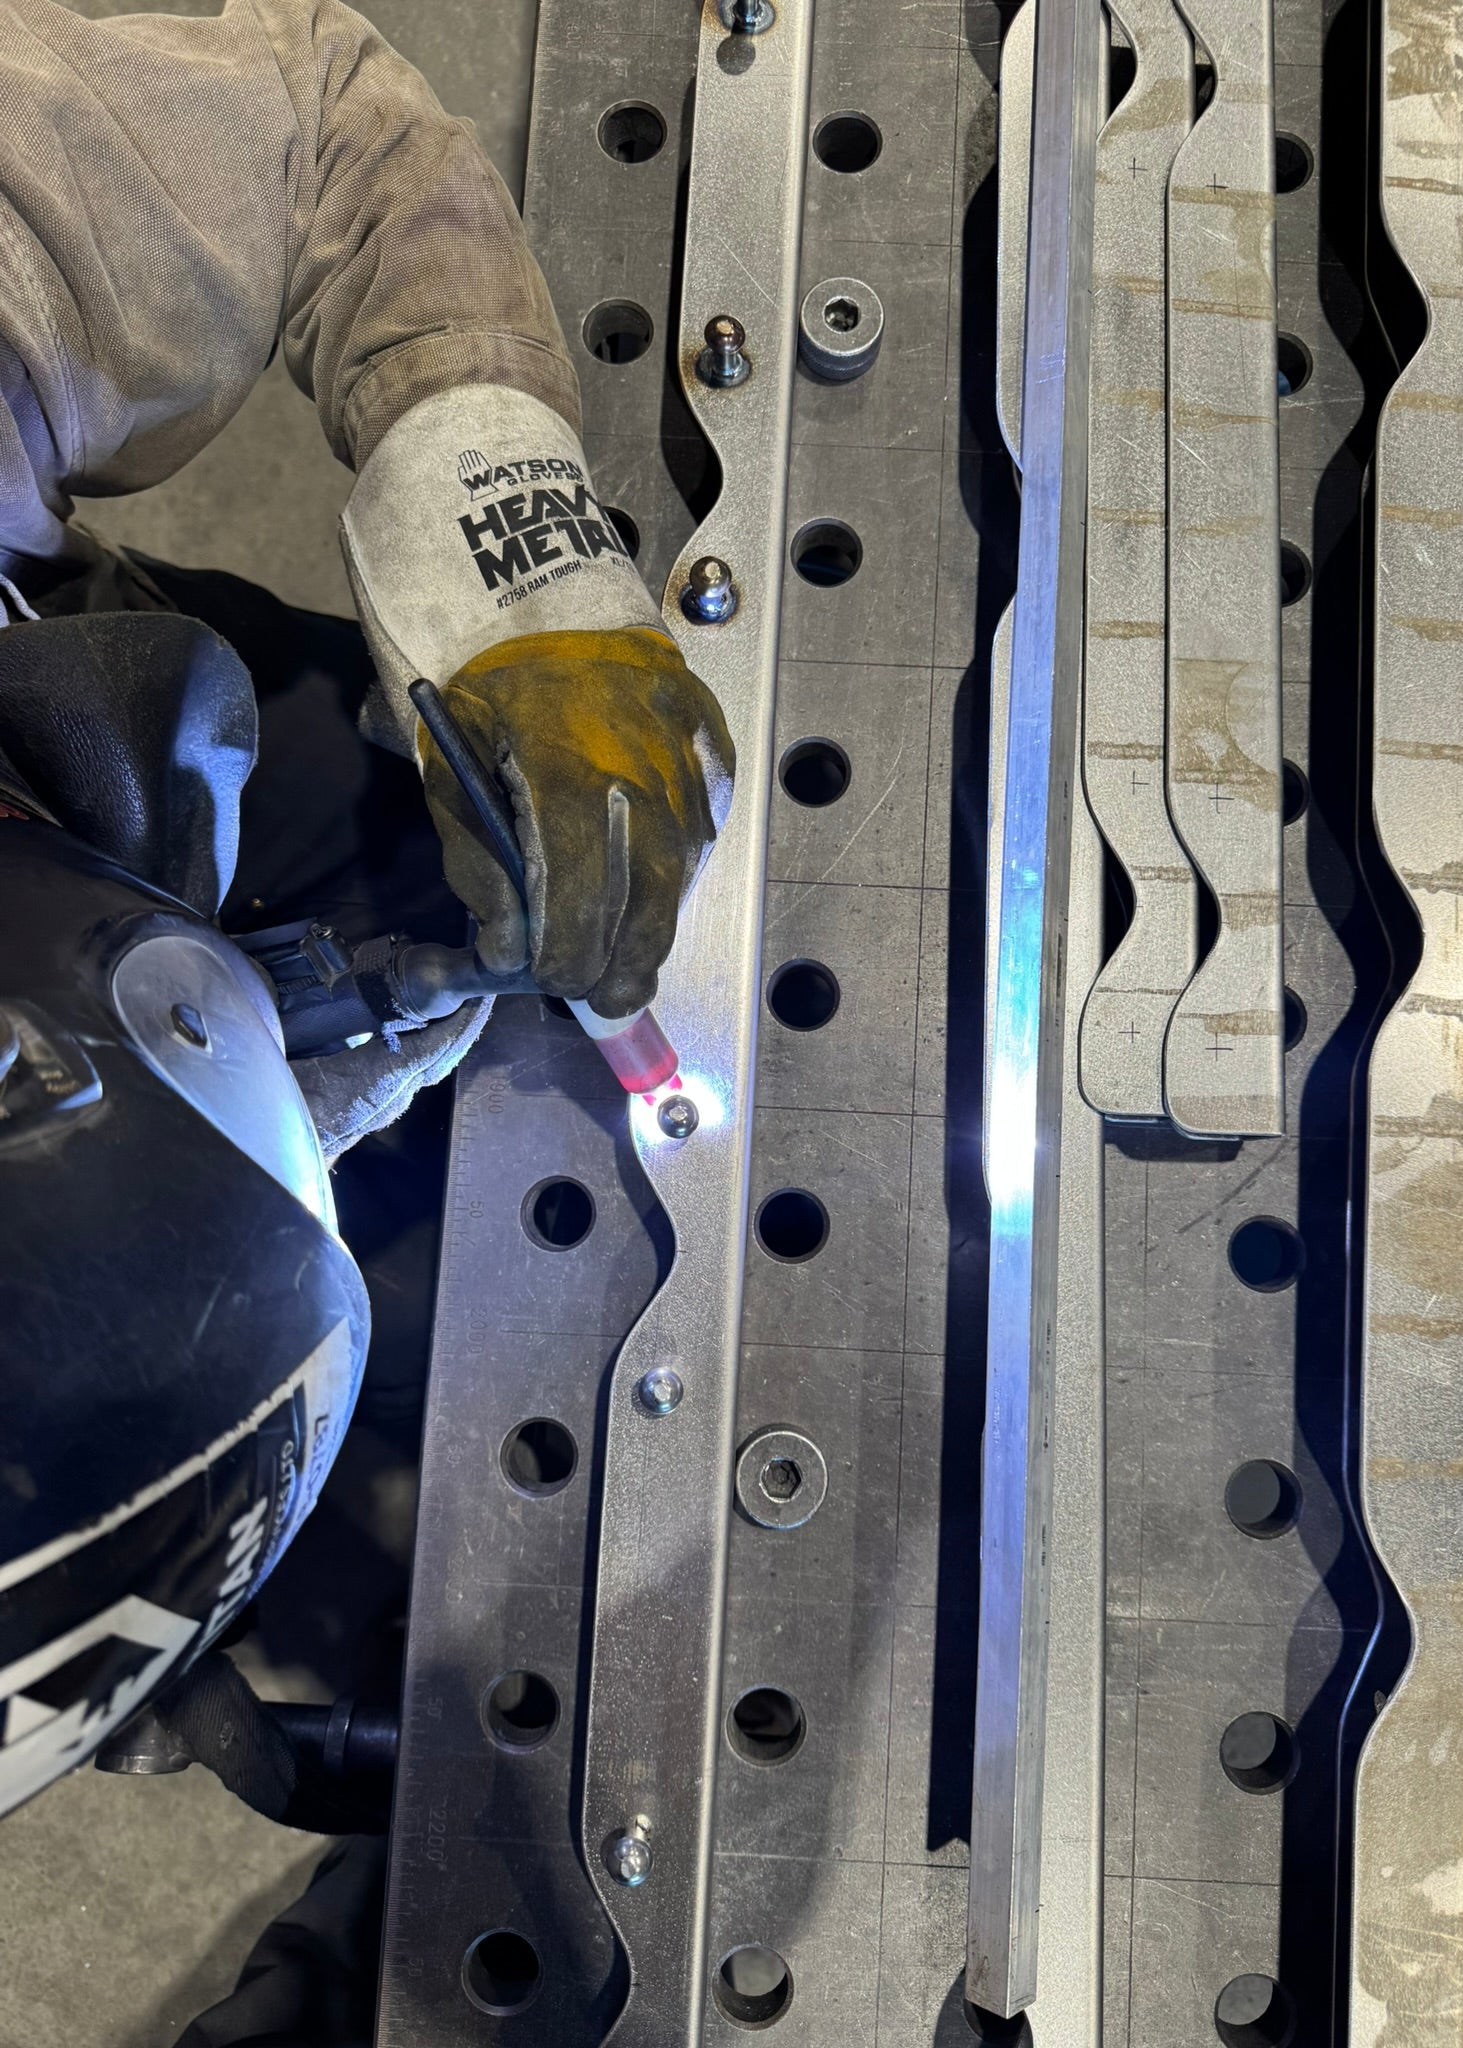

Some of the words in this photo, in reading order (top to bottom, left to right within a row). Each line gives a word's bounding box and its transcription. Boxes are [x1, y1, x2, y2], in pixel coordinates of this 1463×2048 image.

[463, 458, 584, 491] WATSON
[507, 472, 579, 486] GLOVES
[496, 585, 528, 610] #2758
[528, 576, 549, 594] RAM
[549, 560, 583, 581] TOUGH
[469, 1200, 485, 1219] 50
[426, 1808, 446, 1862] 2200
